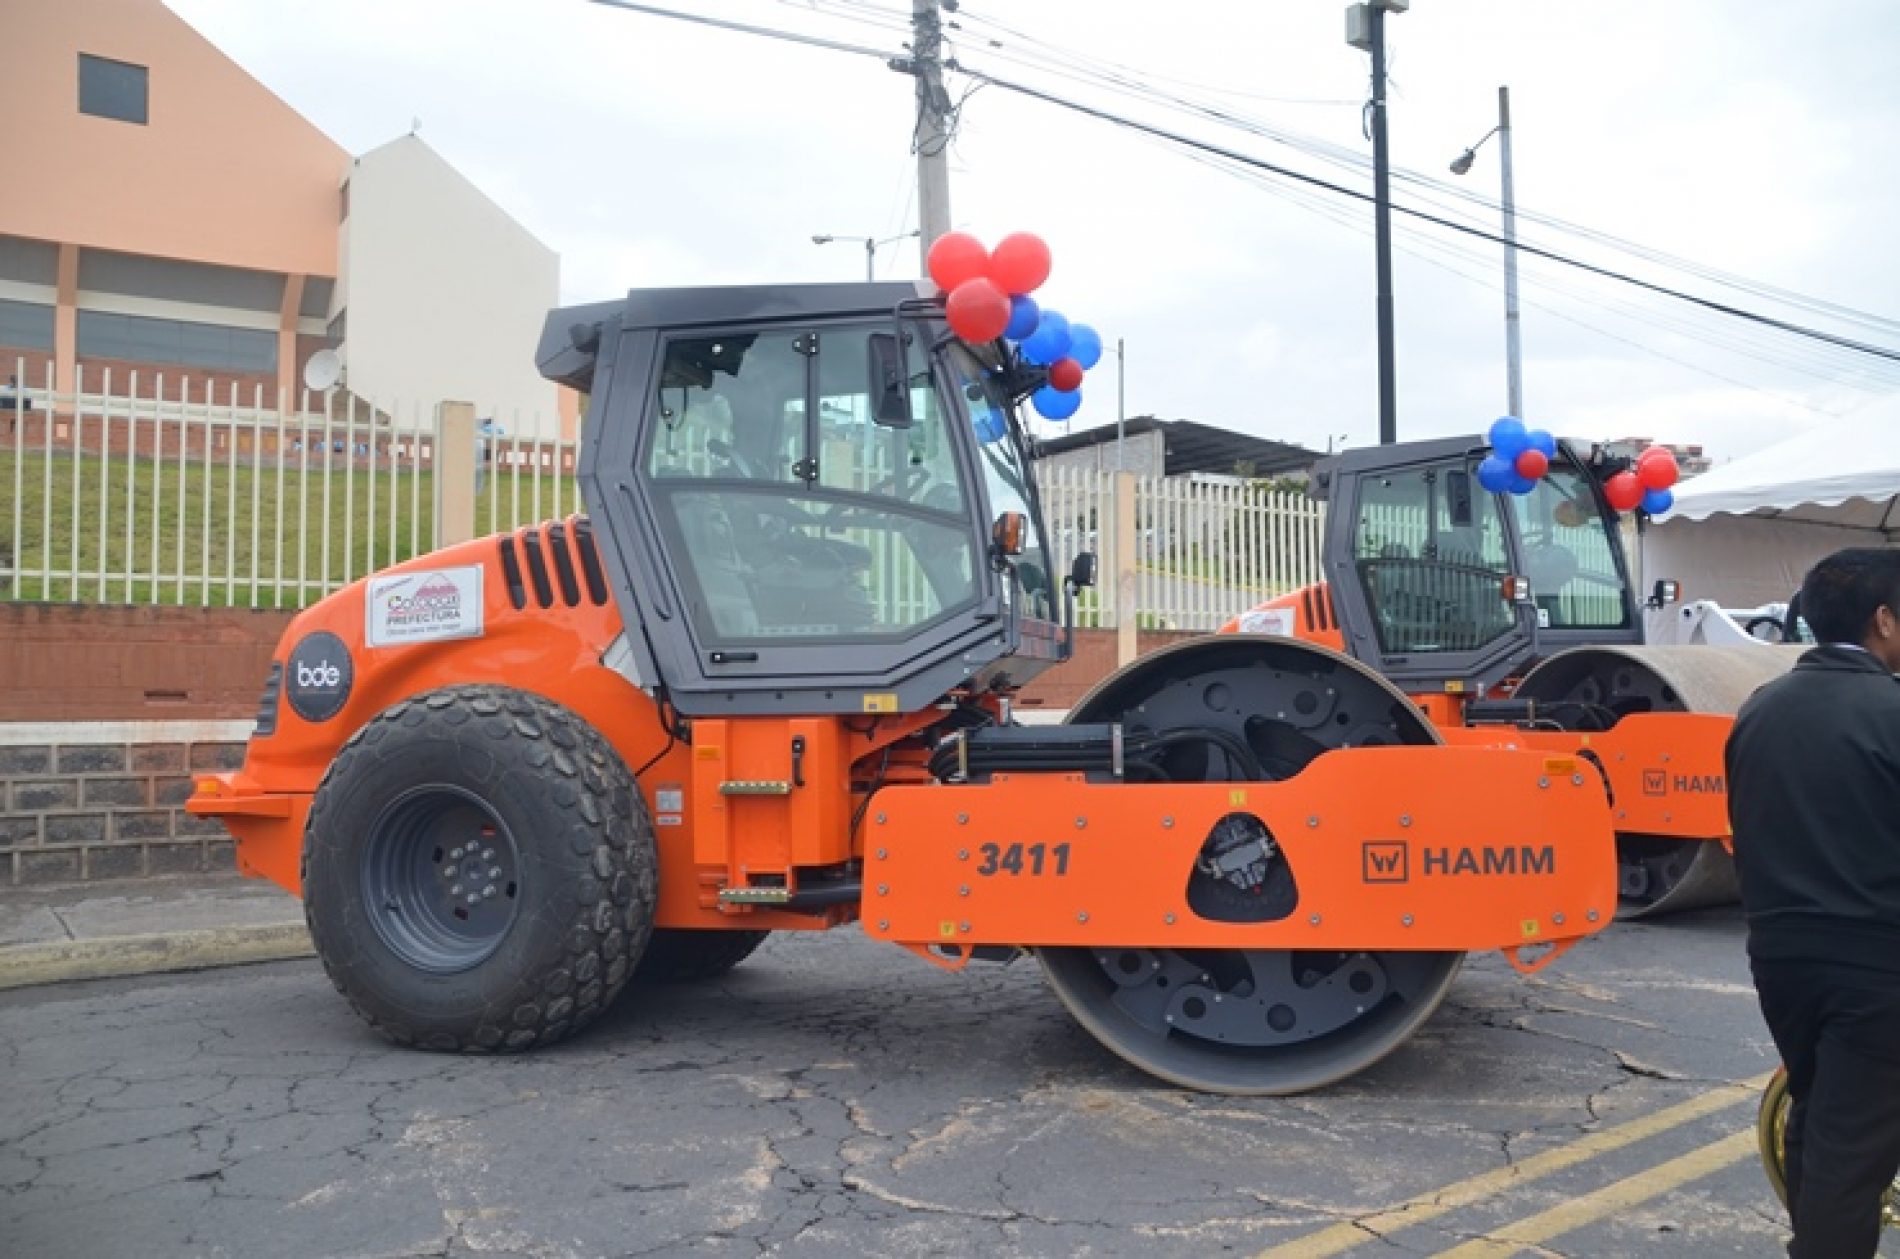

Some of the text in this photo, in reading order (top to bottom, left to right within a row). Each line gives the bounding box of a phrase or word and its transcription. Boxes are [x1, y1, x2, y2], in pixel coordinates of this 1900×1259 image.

[298, 659, 340, 687] bde
[1673, 775, 1726, 794] HAM
[977, 842, 1071, 877] 3411
[1422, 847, 1555, 876] HAMM
